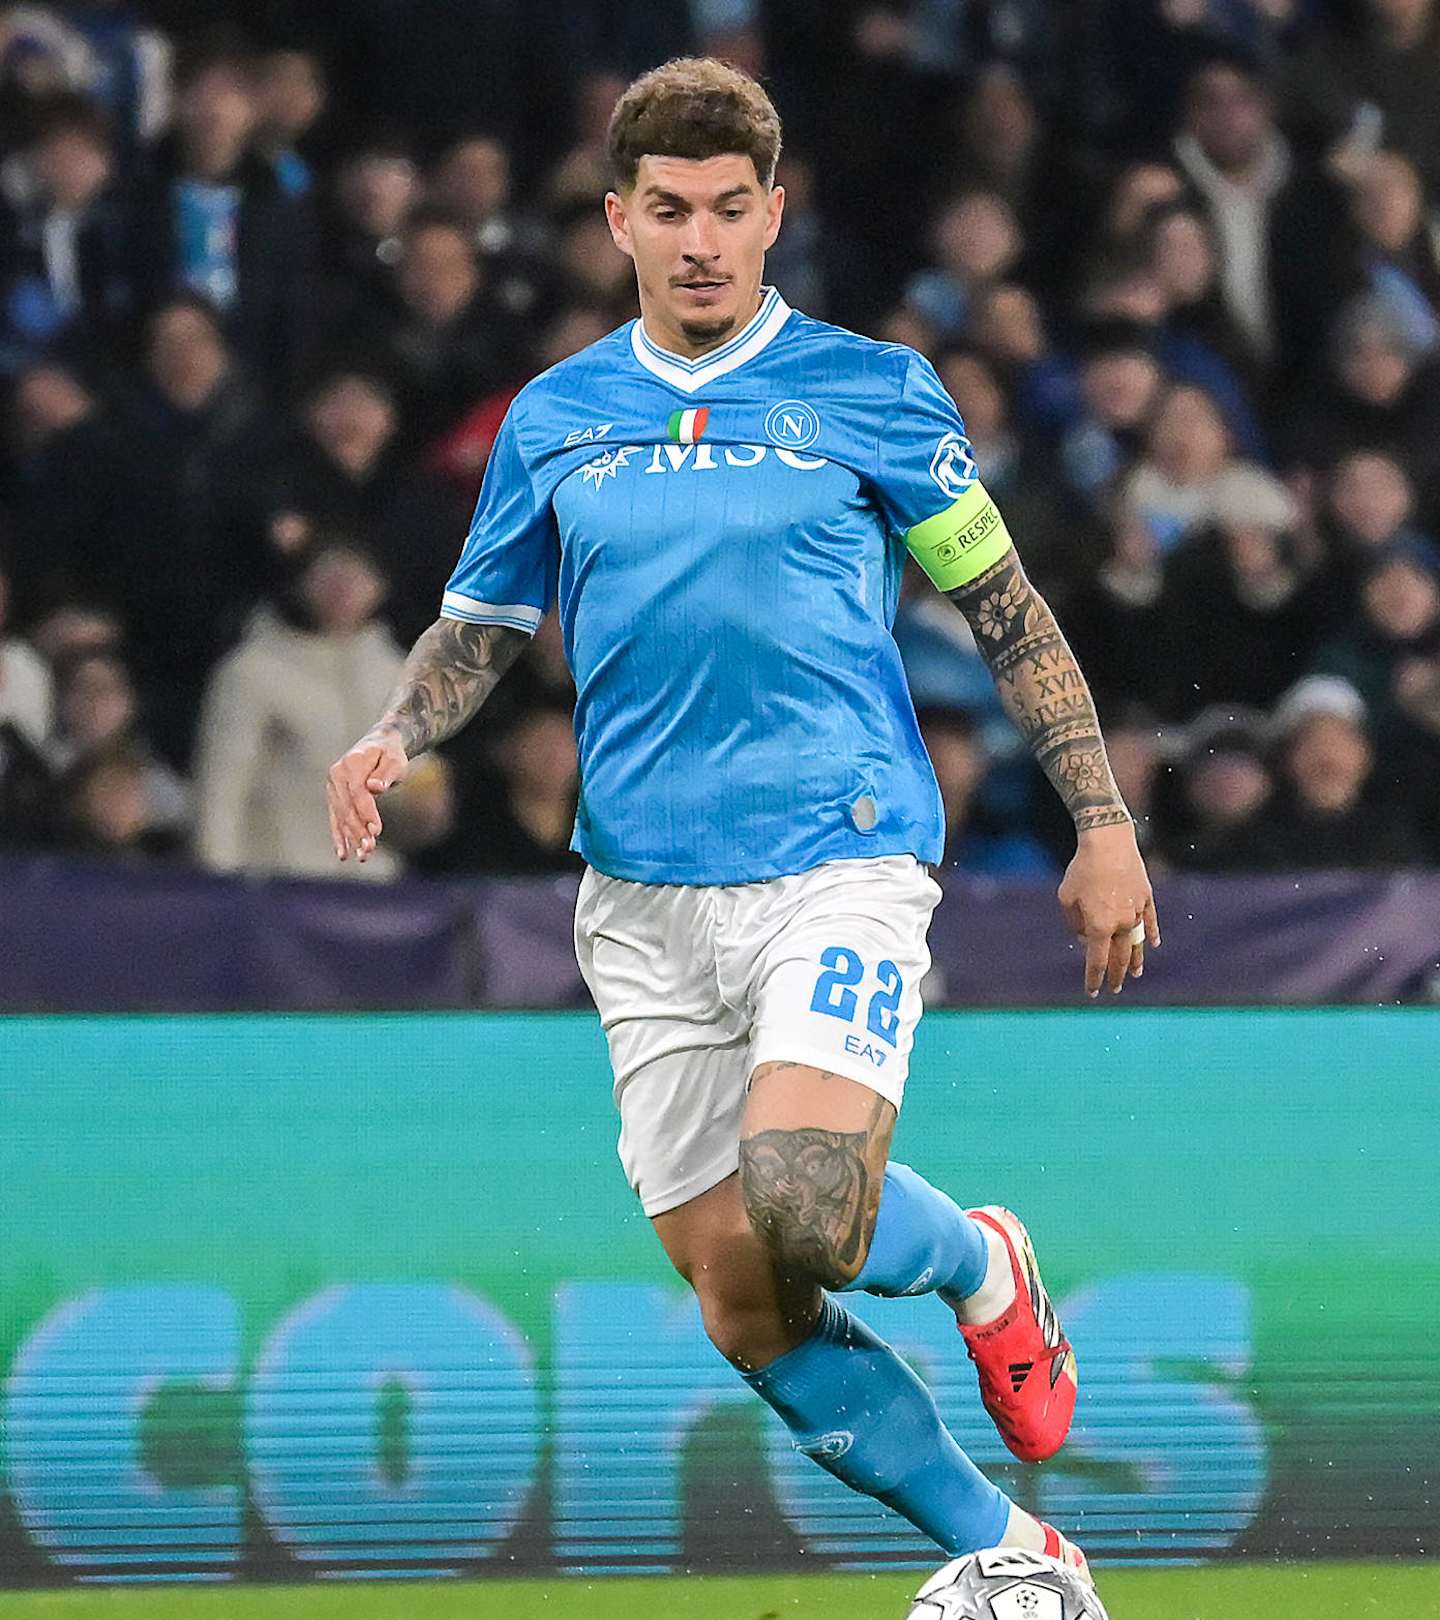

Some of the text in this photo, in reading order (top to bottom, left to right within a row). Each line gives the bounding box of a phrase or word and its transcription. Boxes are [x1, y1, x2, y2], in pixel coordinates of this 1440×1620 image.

[564, 423, 613, 446] EA7
[781, 414, 804, 439] N
[809, 946, 903, 1049] 22
[844, 1034, 887, 1067] EA7
